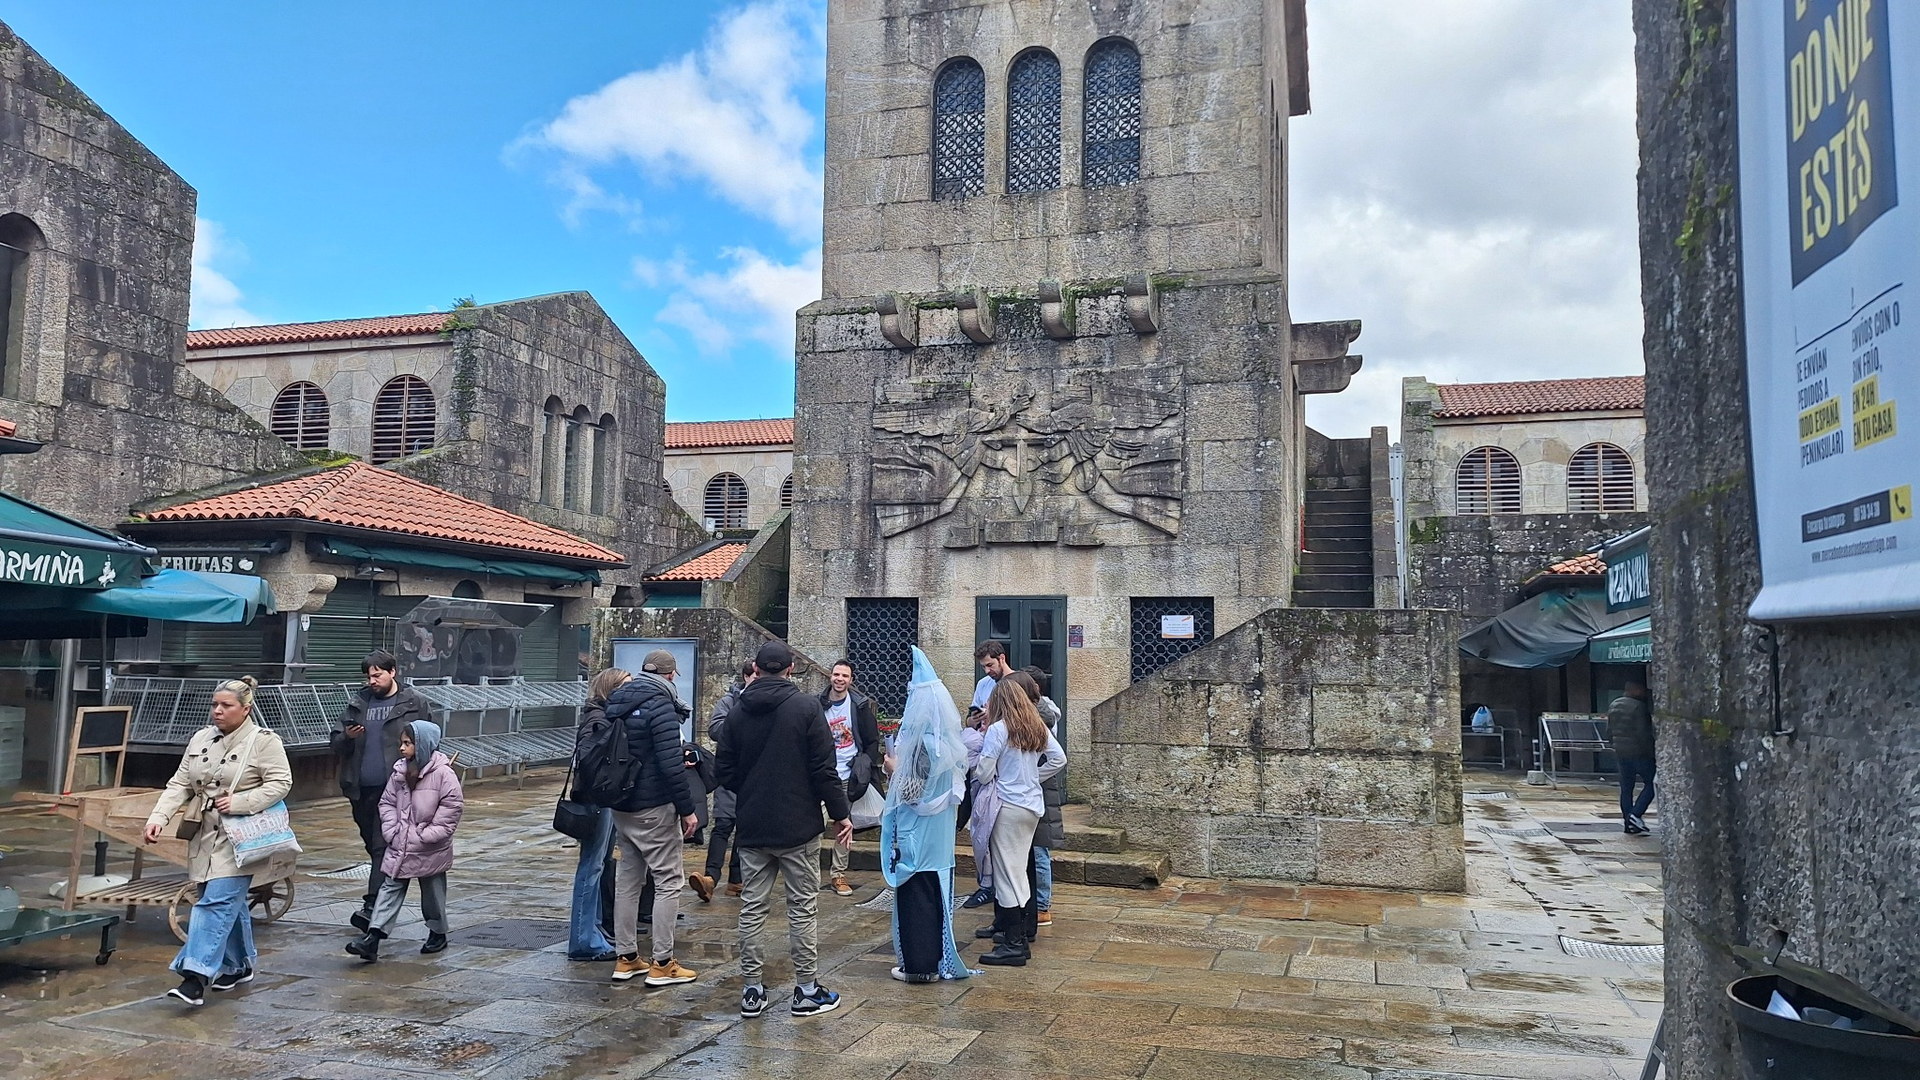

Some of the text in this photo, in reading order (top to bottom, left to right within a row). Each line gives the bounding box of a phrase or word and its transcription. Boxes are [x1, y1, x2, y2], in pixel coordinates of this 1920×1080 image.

[1791, 0, 1873, 142] DONDE
[1800, 90, 1872, 252] ESTÉS
[1874, 305, 1891, 336] CON
[1892, 301, 1900, 327] O
[1872, 407, 1893, 437] CASA
[161, 556, 233, 573] FRUTAS
